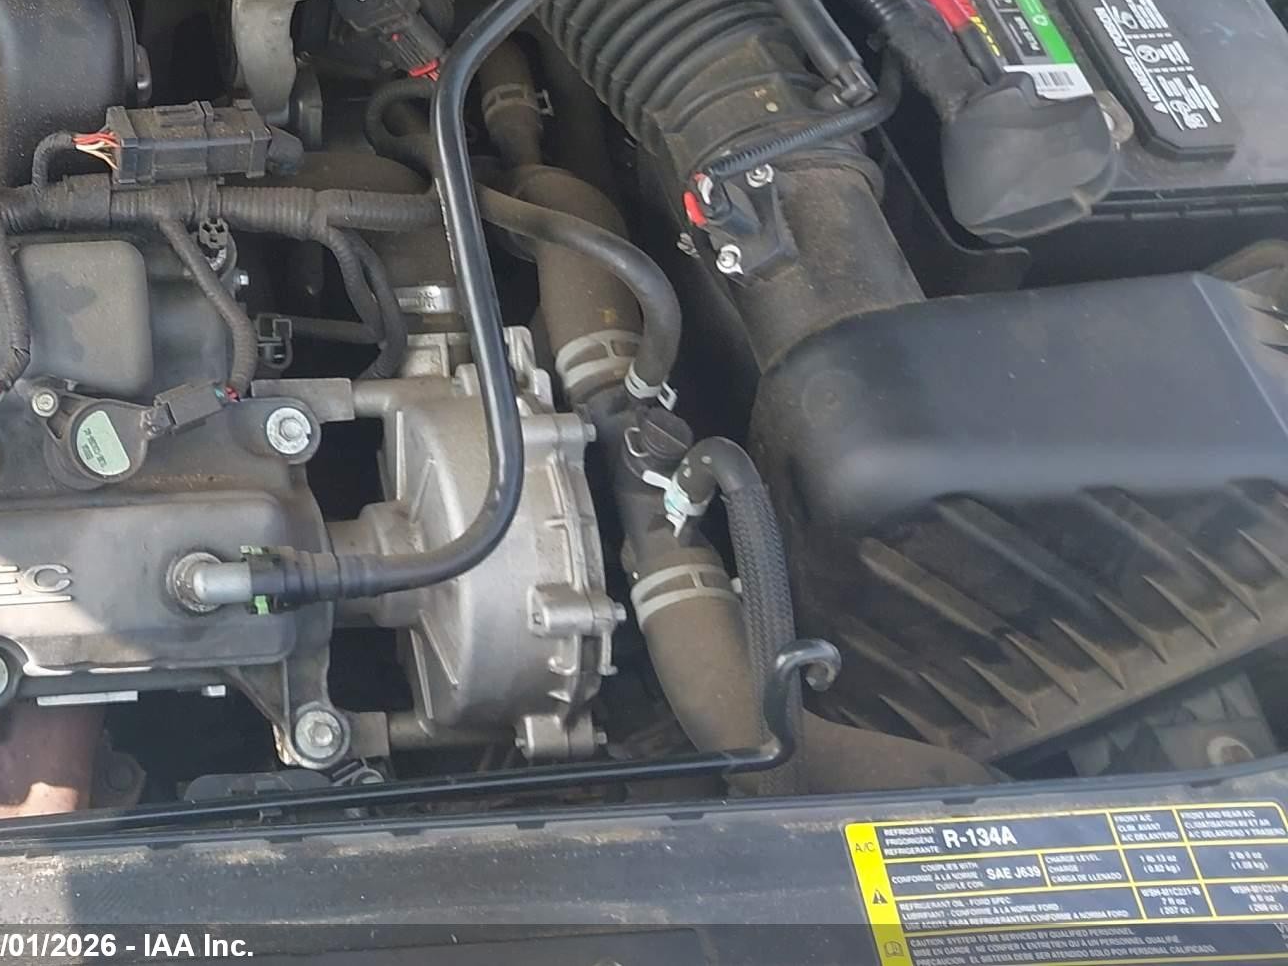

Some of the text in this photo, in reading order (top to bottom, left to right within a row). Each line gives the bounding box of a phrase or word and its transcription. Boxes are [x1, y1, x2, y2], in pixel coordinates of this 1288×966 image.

[1093, 6, 1127, 48] POISON
[855, 841, 876, 852] A/C
[942, 825, 1018, 850] R-134A
[986, 866, 1041, 880] SAE J639
